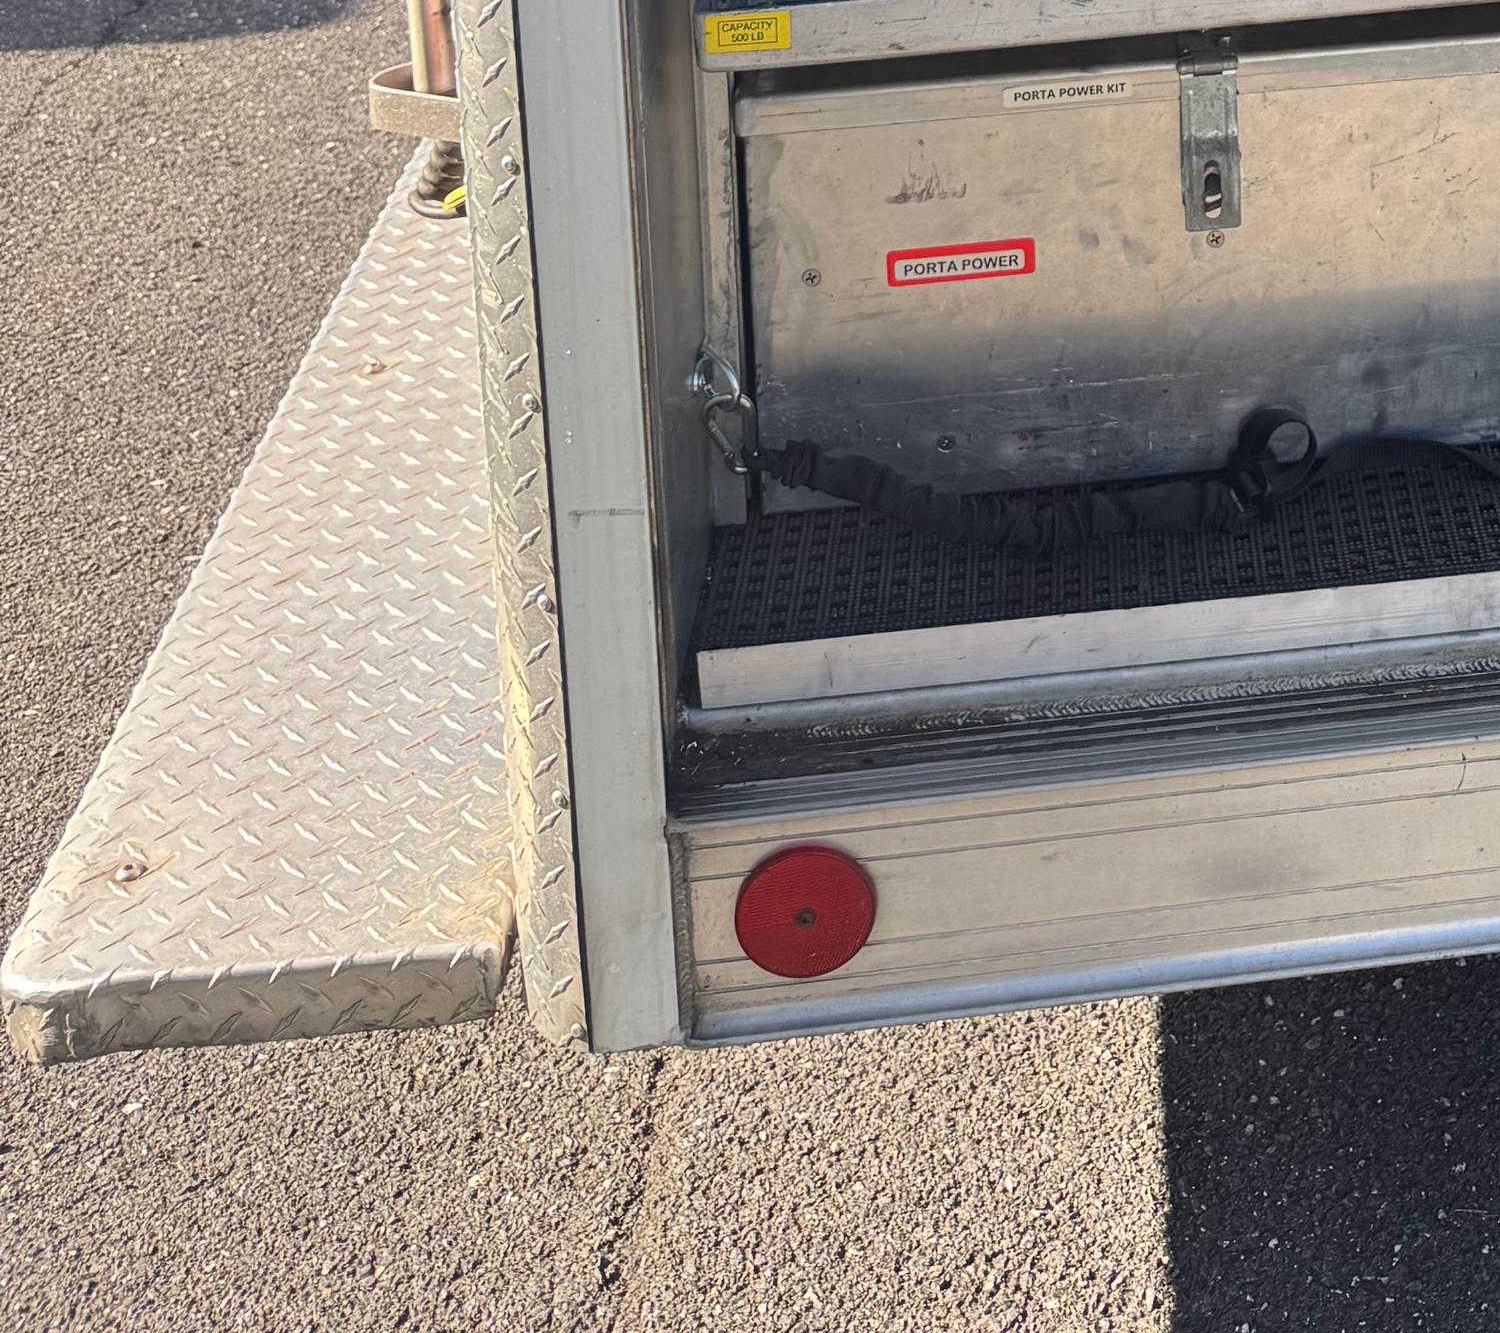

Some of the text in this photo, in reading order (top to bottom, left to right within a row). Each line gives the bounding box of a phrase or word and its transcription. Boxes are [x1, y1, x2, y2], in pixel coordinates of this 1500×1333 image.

[721, 21, 773, 32] CAPACITY
[731, 32, 764, 42] 500 LB
[1014, 82, 1127, 102] PORTA POWER KIT
[904, 254, 1019, 276] PORTA POWER
